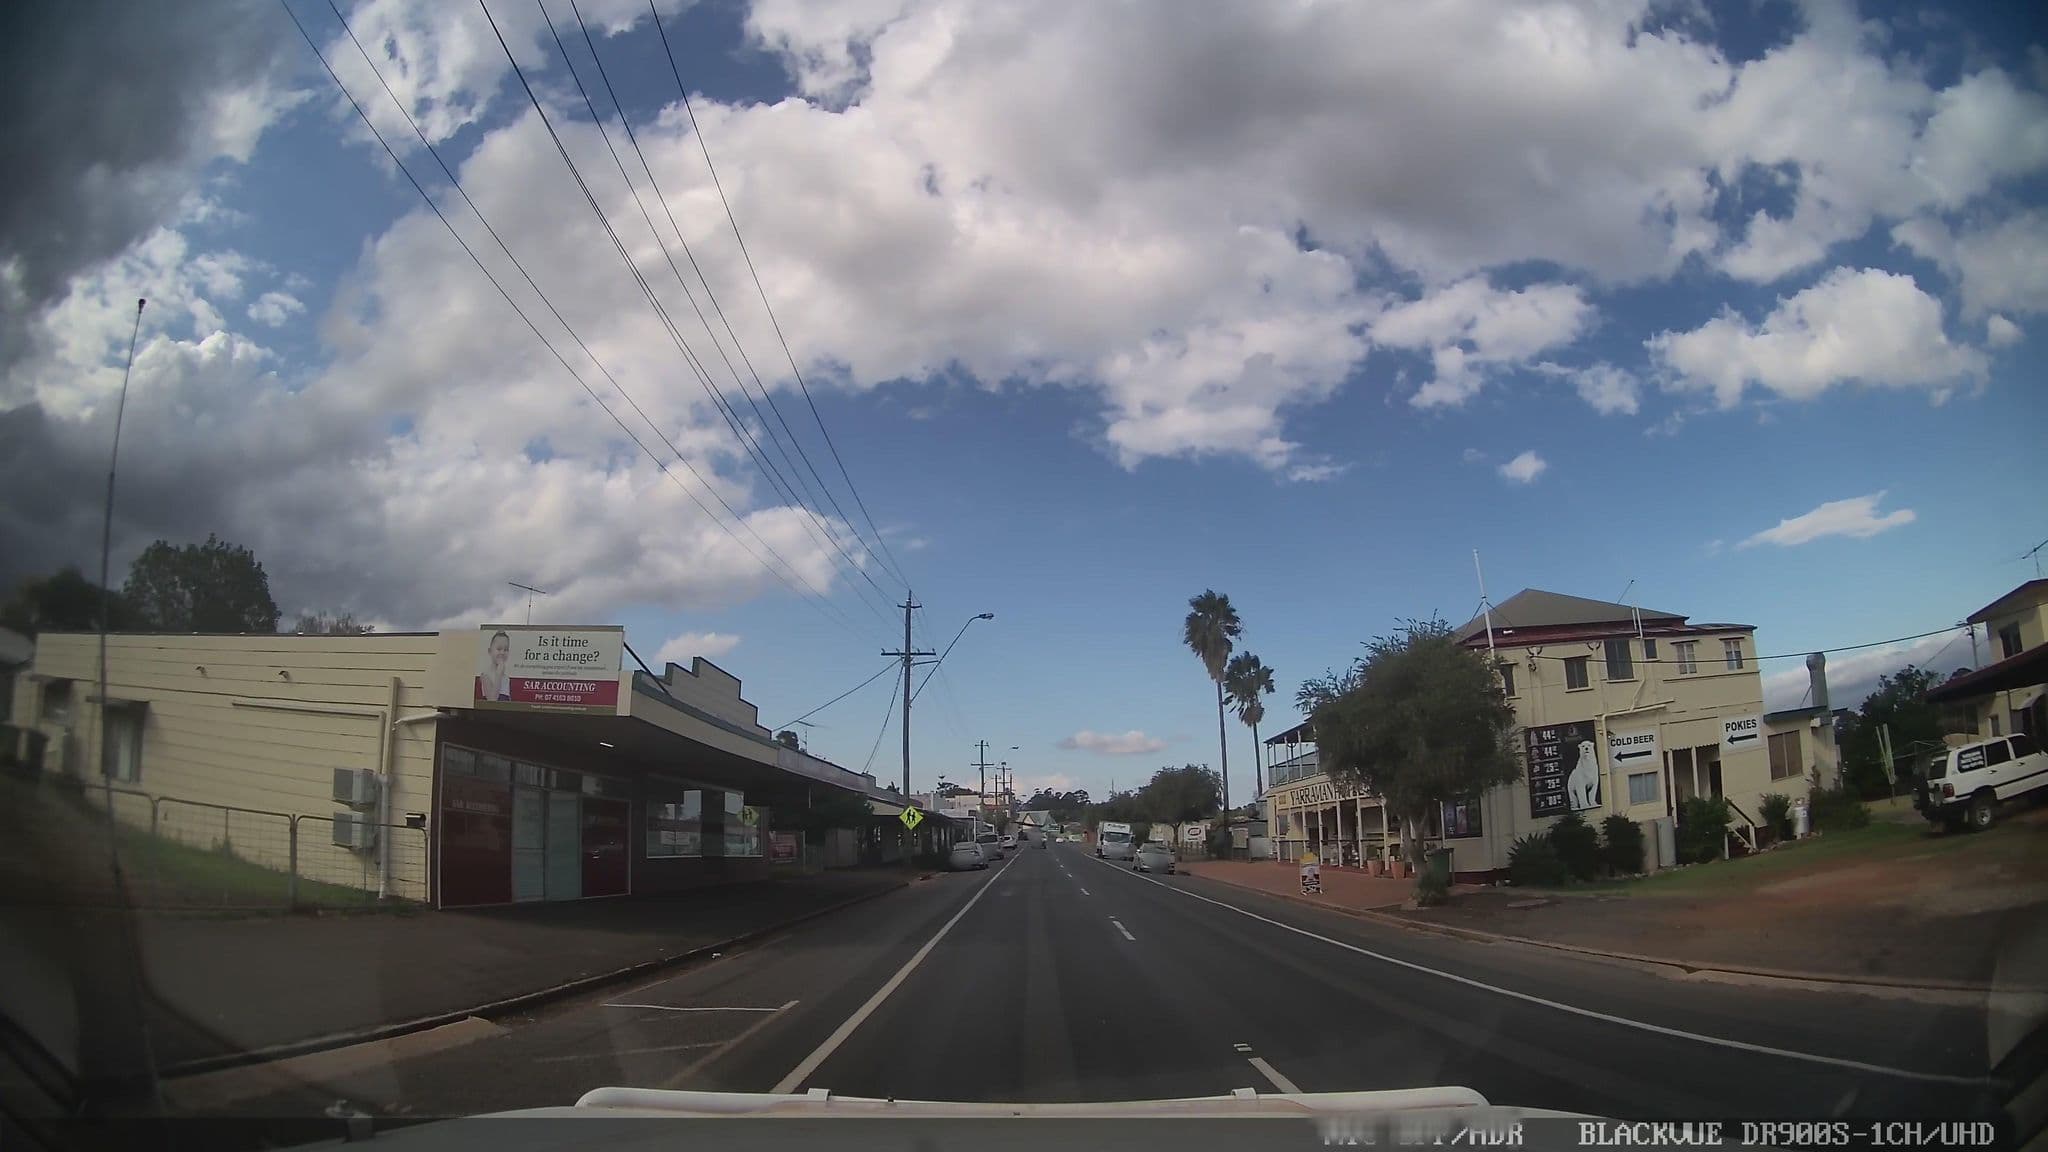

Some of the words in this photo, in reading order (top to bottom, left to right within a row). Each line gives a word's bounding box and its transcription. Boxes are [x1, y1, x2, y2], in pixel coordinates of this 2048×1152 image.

[538, 636, 548, 647] Is
[551, 636, 559, 647] it
[562, 636, 588, 647] time
[525, 649, 541, 660] for
[543, 652, 549, 660] a
[552, 650, 600, 664] change?
[523, 681, 540, 690] SAR
[541, 682, 596, 692] ACCOUNTING
[1725, 719, 1757, 732] POKIES
[1610, 737, 1632, 747] COLD
[1633, 734, 1654, 745] BEER
[1290, 783, 1333, 805] YARRAMAN
